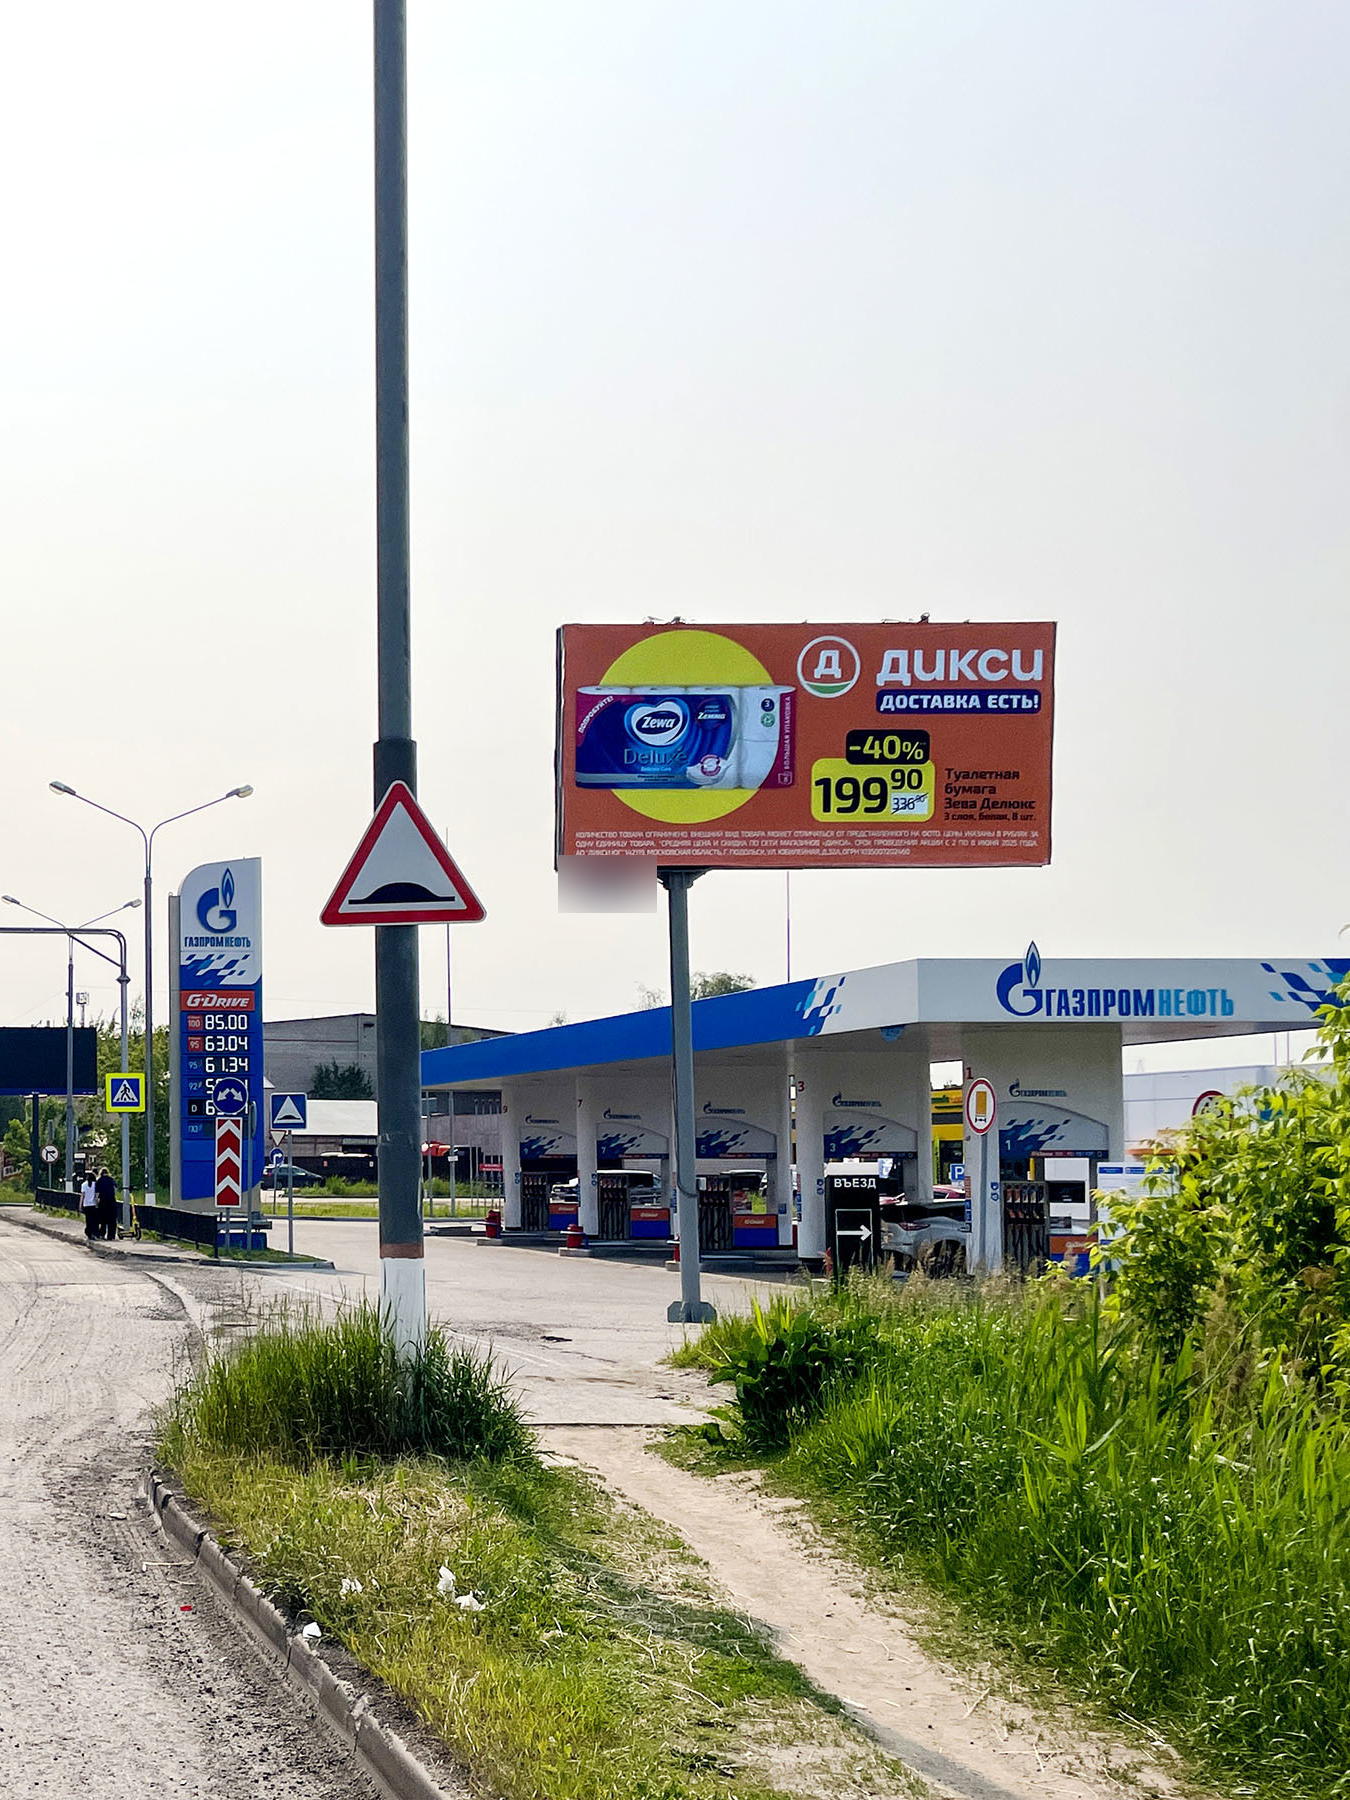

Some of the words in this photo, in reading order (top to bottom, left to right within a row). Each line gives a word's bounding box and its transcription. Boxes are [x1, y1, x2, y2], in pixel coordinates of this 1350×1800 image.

[880, 695, 981, 711] ДОСТАВКА
[987, 695, 1039, 709] ЕСТЬ!
[641, 716, 676, 729] Zewa
[624, 747, 688, 765] Deluxe
[944, 768, 1020, 782] Туалетная
[814, 777, 889, 814] 199
[891, 768, 923, 790] 90
[944, 783, 997, 797] бумага
[944, 797, 977, 809] Зева
[980, 797, 1036, 811] Делюкс
[184, 936, 251, 948] ГАЗПРОМНЕФТЬ
[1045, 989, 1234, 1017] ГАЗПРОМНЕФТЬ
[204, 1014, 248, 1030] 85.00
[204, 1035, 248, 1052] 63.04
[205, 1057, 248, 1073] 61.34
[834, 1178, 877, 1190] ВЪЕЗД
